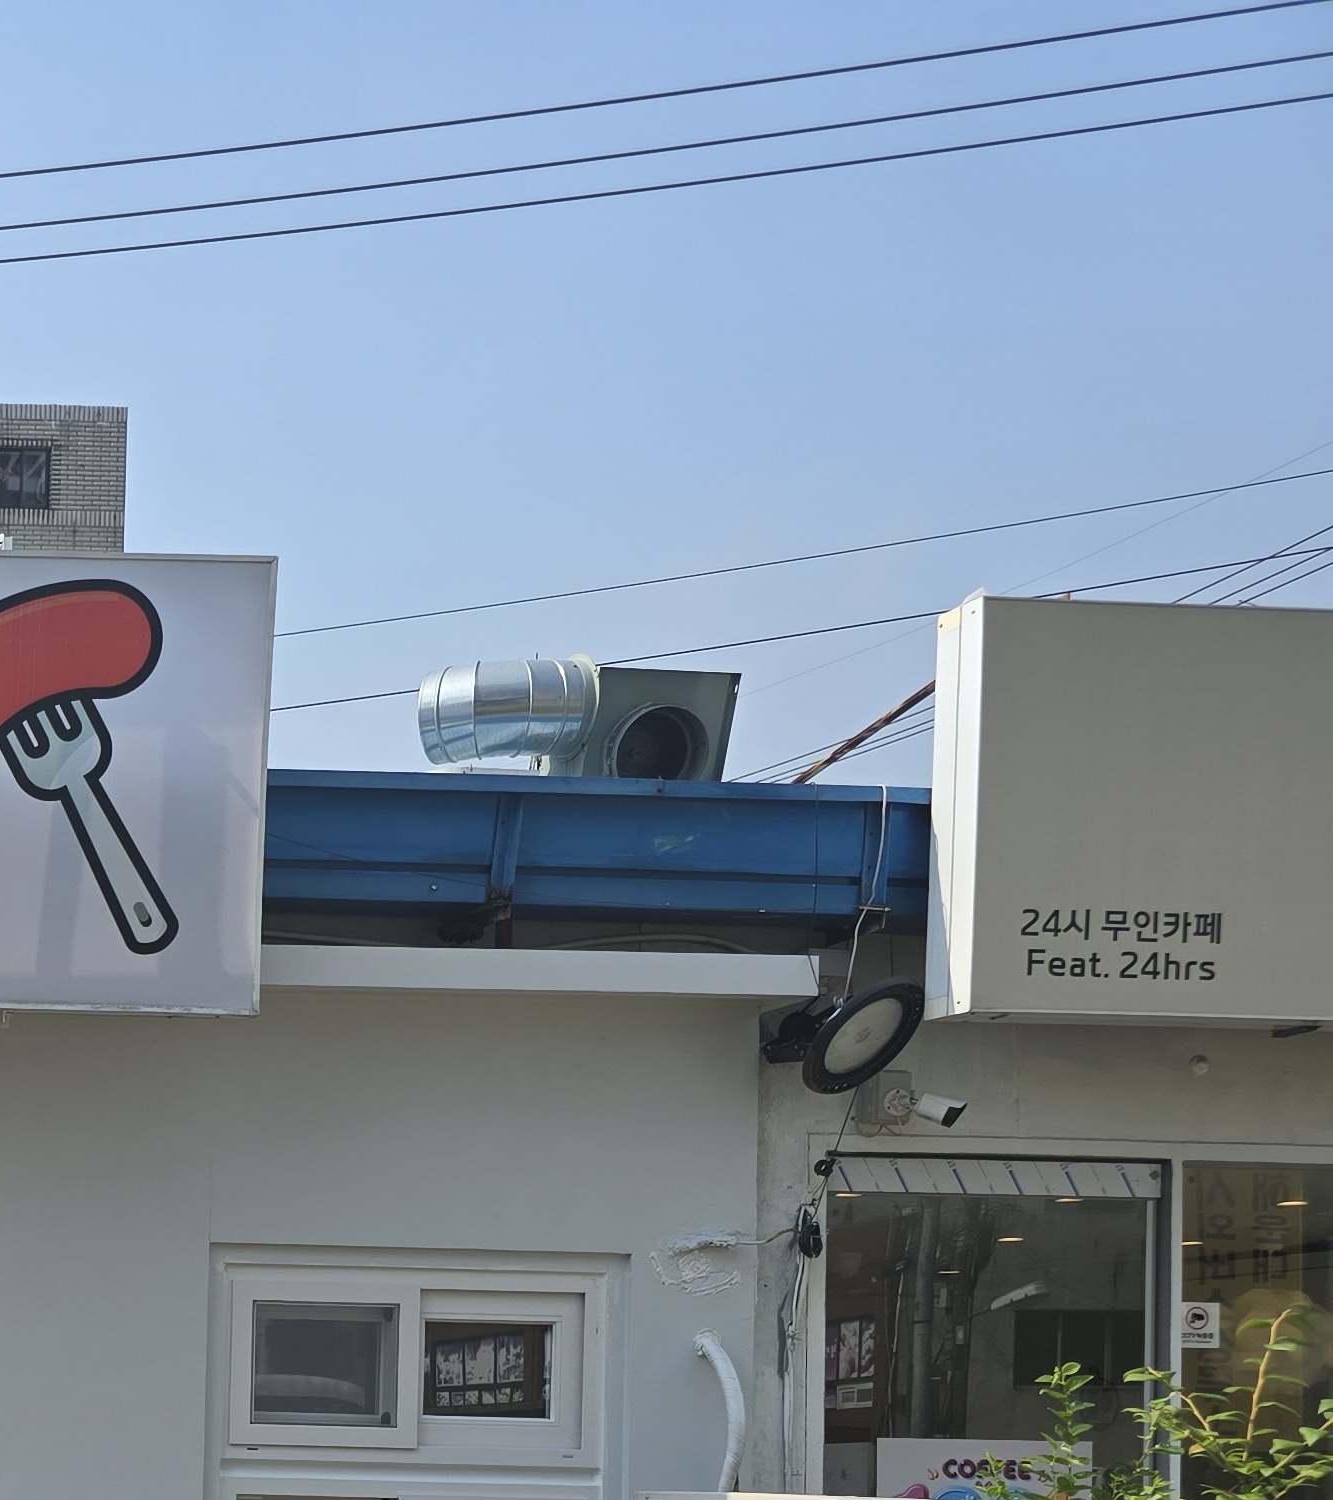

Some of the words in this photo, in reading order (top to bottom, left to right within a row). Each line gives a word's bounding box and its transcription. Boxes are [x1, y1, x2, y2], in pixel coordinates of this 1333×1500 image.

[1020, 909, 1091, 940] 24시
[1100, 909, 1223, 946] 무인카페
[1026, 949, 1110, 980] Feat.
[1118, 951, 1216, 982] 24hrs
